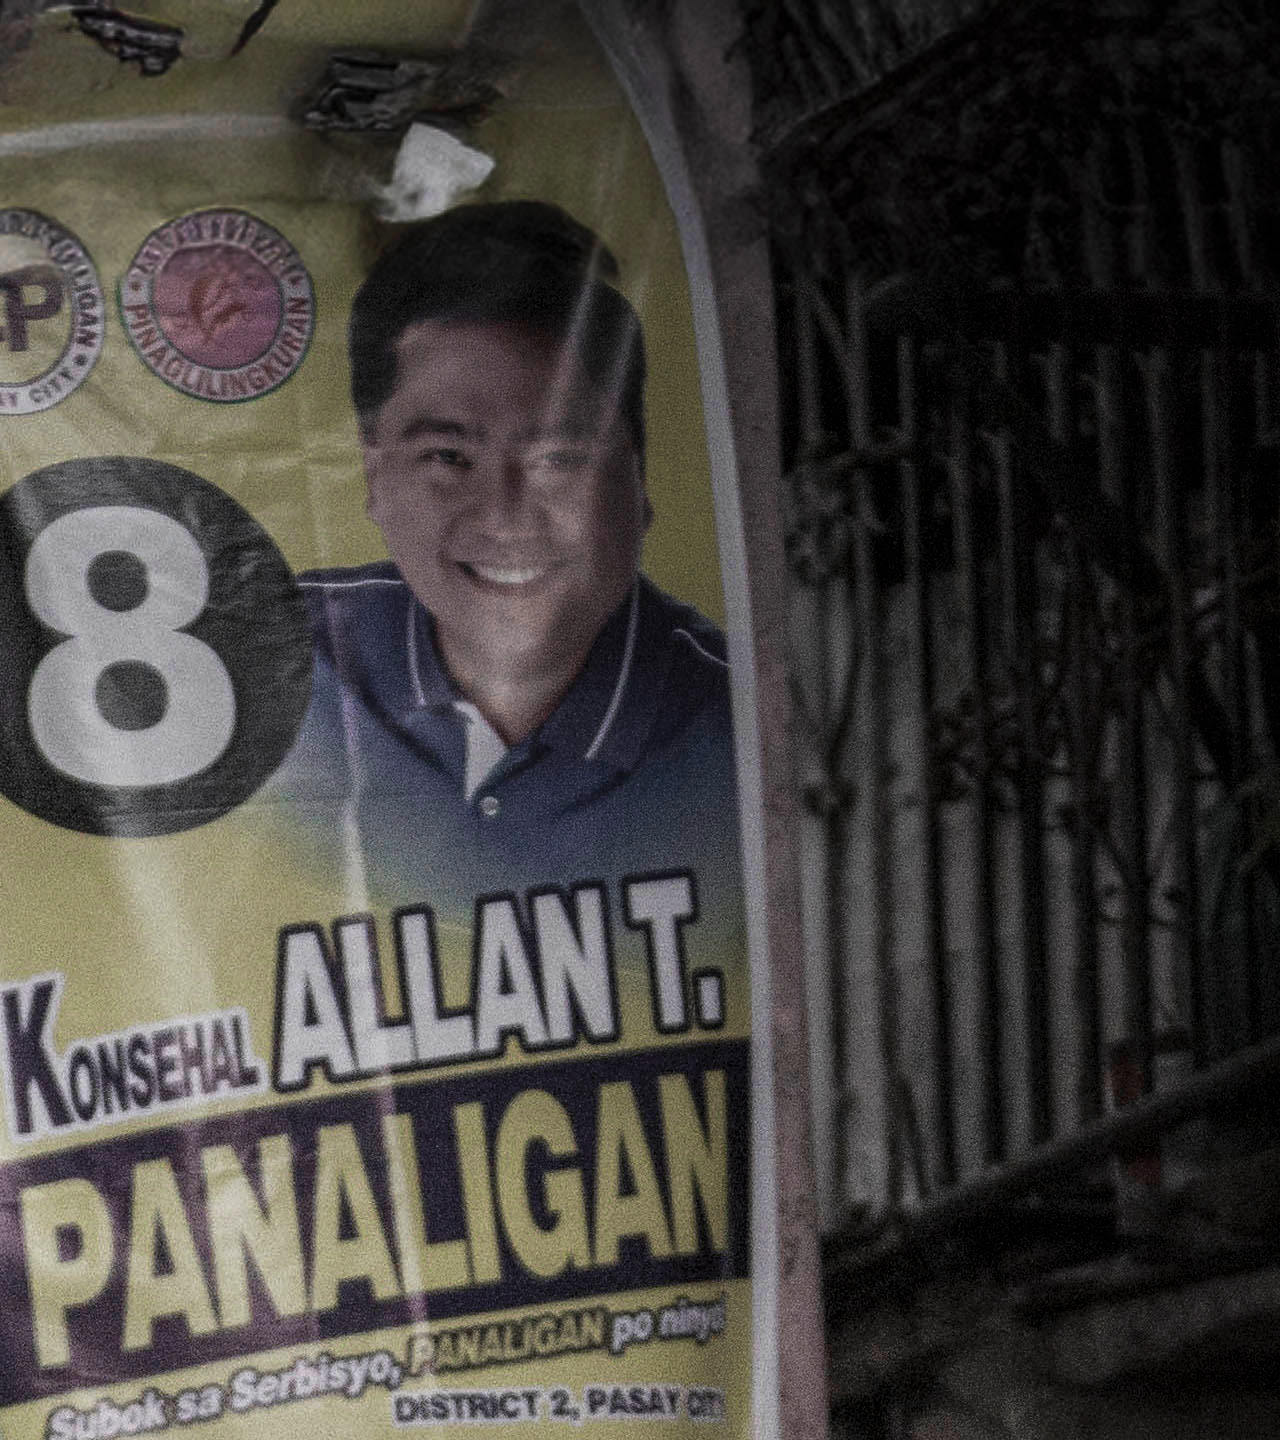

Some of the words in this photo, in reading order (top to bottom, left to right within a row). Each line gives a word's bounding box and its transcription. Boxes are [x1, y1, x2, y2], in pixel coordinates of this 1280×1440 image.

[25, 504, 238, 789] 8
[0, 978, 264, 1134] KONSEHAL
[276, 882, 620, 1092] ALLAN
[624, 870, 728, 1034] T.
[20, 1068, 729, 1370] PANALIGAN
[174, 1380, 226, 1424] sa
[228, 1350, 404, 1414] Serbisyo,
[409, 1304, 609, 1376] PANALIGAN
[611, 1310, 655, 1354] po
[393, 1390, 540, 1424] DISTRICT
[548, 1386, 584, 1424] 2,
[586, 1384, 682, 1418] PASAY
